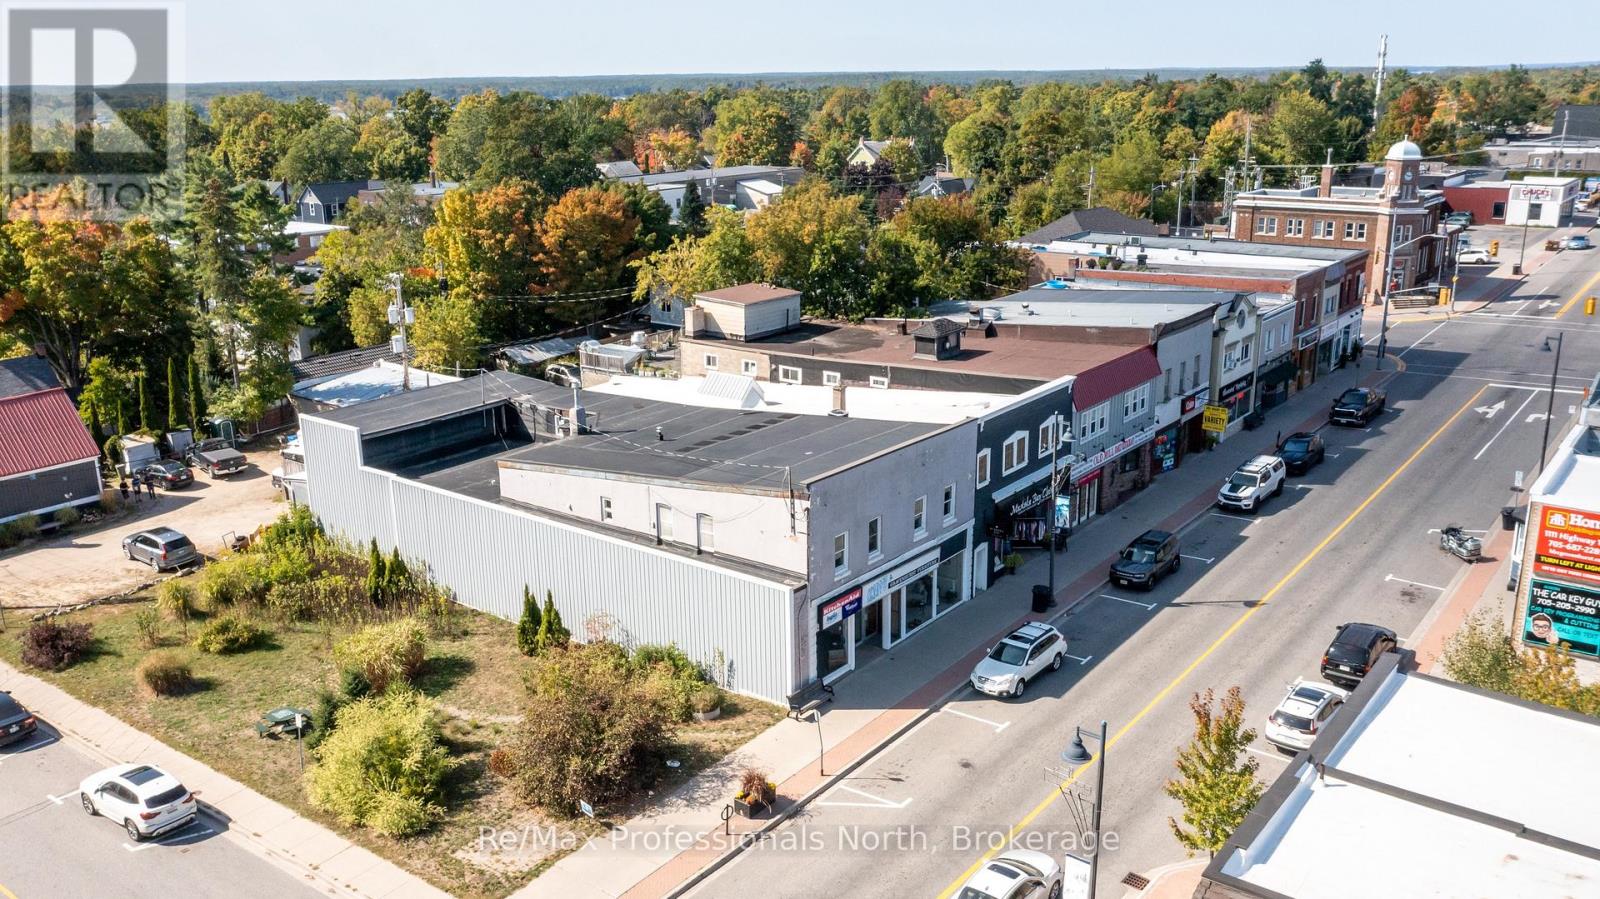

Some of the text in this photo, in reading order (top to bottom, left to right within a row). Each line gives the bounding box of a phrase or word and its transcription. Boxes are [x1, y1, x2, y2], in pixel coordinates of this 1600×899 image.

[1204, 415, 1226, 425] VARIETY
[1559, 532, 1597, 546] Highway
[1540, 555, 1559, 564] TURN
[1560, 559, 1575, 567] LEFT
[1532, 587, 1550, 598] THE
[1551, 591, 1567, 601] CAR
[1568, 594, 1585, 604] KEY
[823, 591, 861, 616] KitchenAid
[1536, 597, 1596, 615] 705-205-2990
[1569, 619, 1600, 630] CUTTING
[1583, 632, 1599, 640] TEXT
